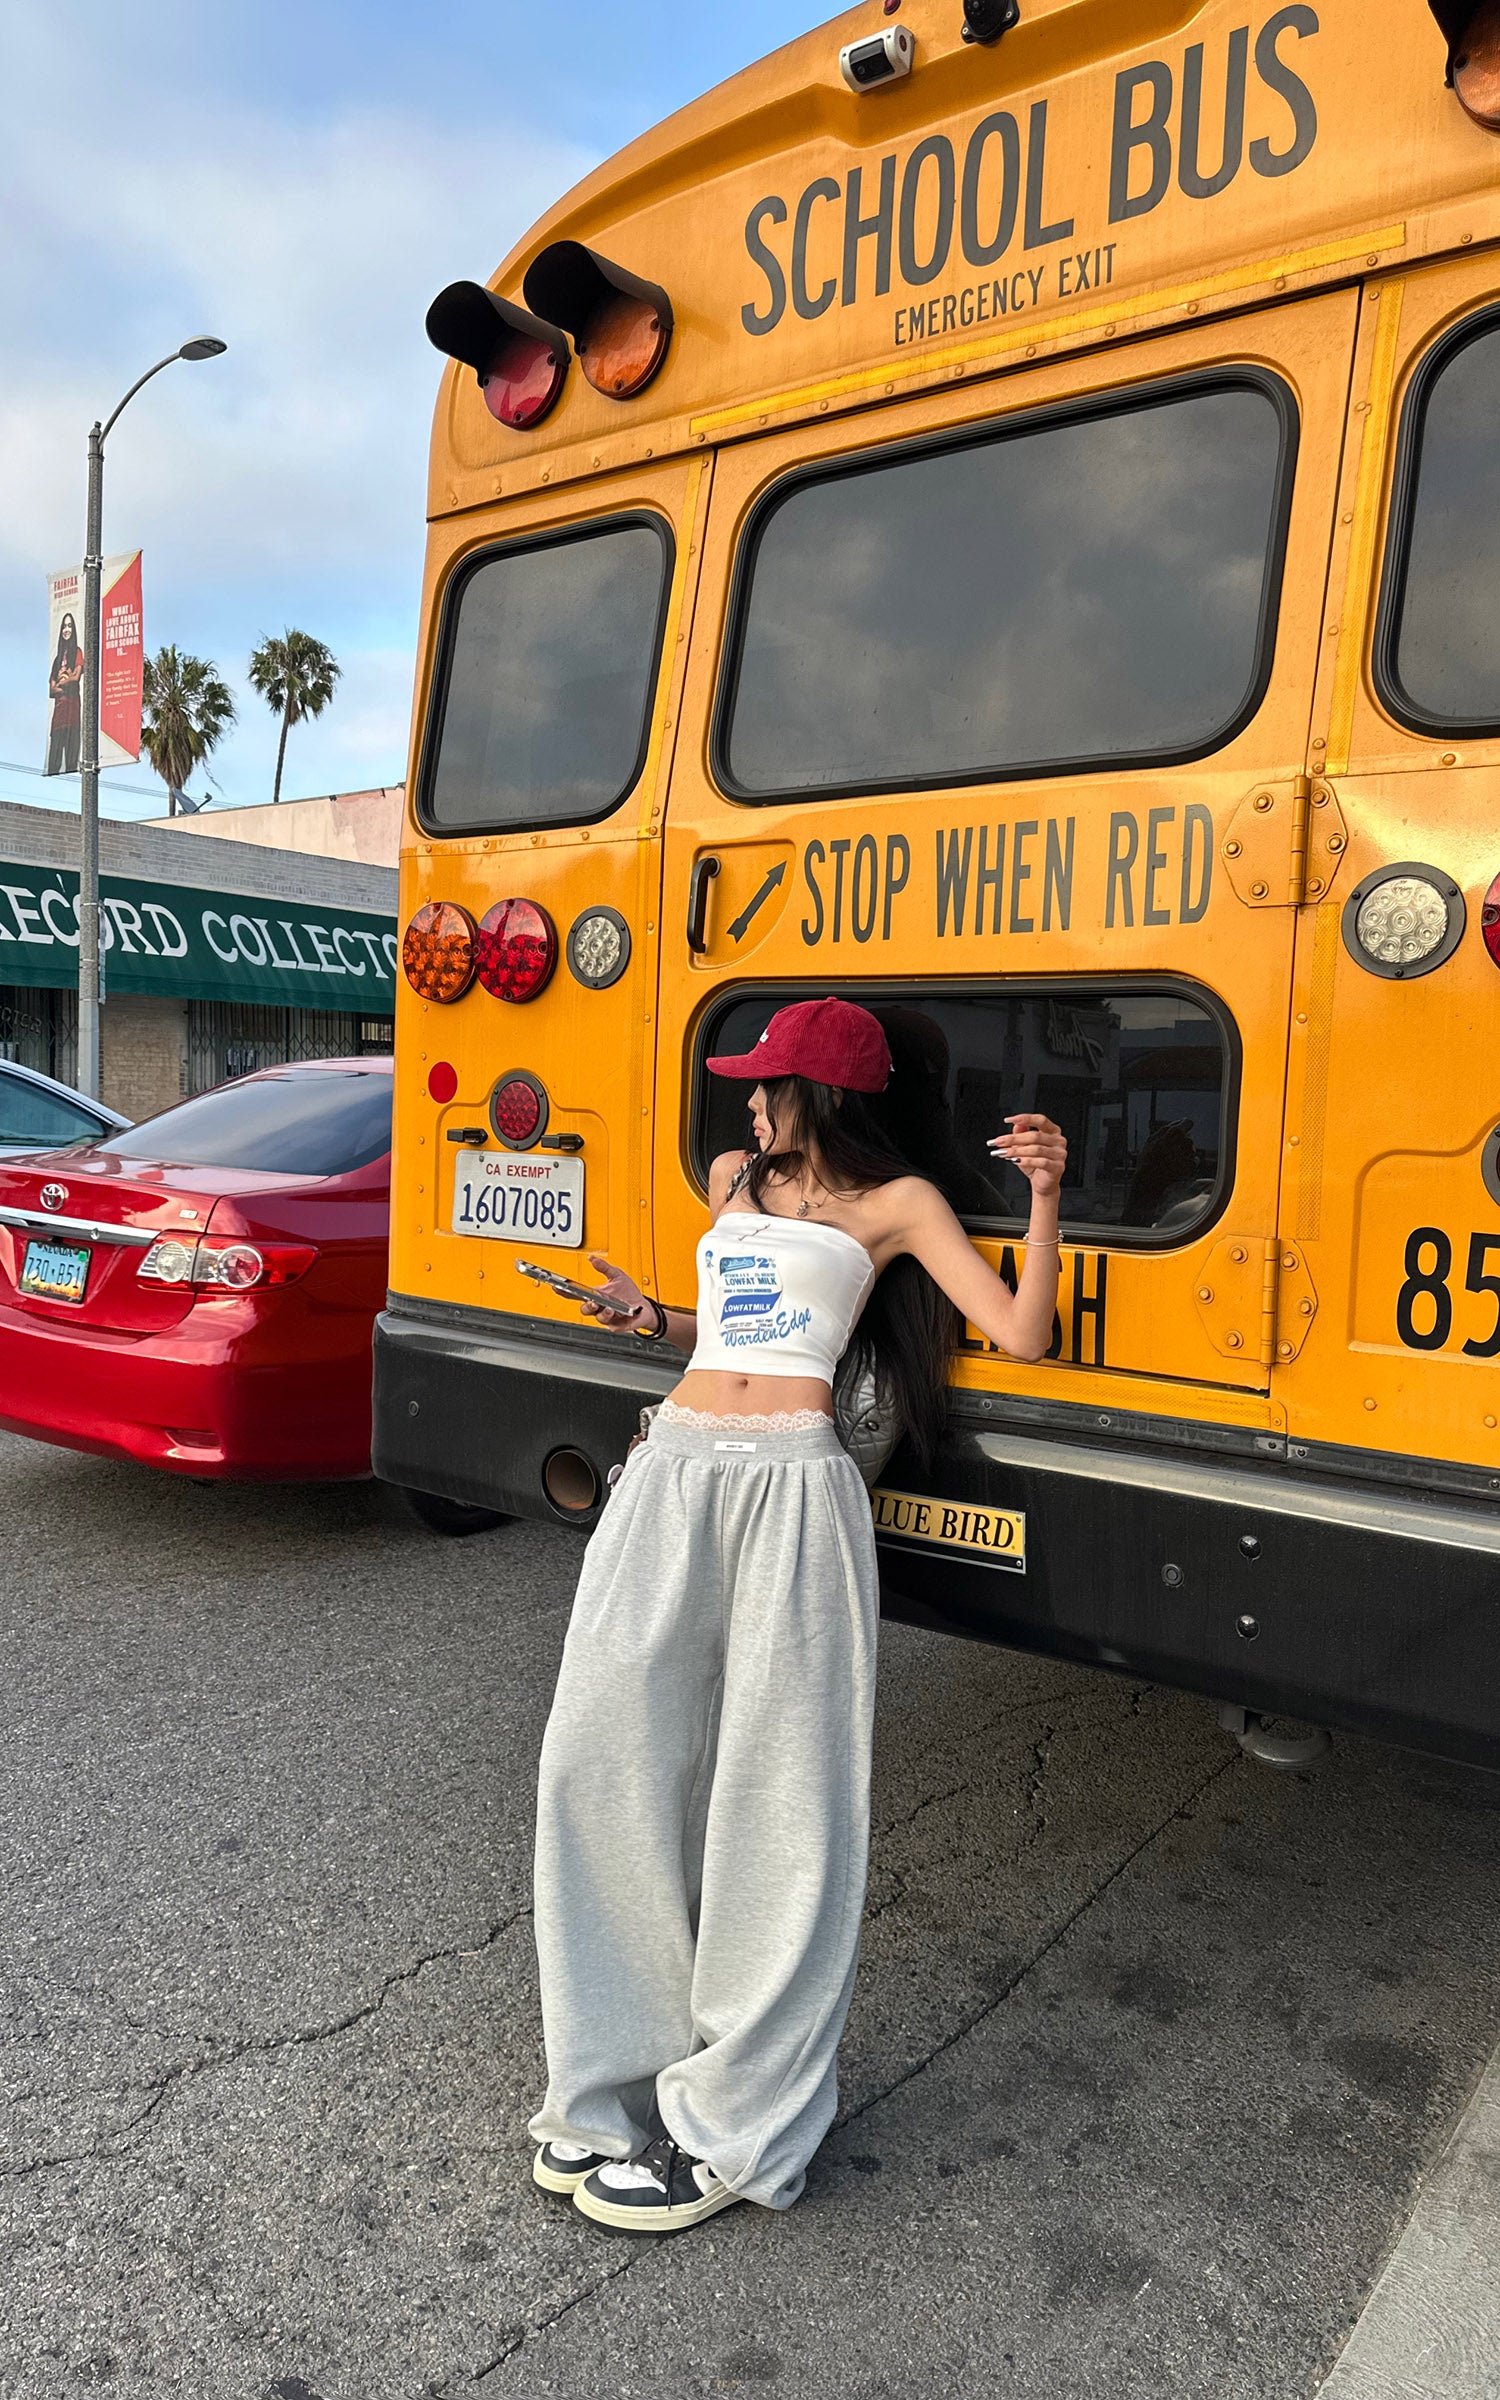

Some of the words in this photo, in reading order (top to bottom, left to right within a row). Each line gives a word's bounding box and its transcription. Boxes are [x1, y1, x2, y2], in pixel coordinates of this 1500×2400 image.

[741, 99, 1074, 336] SCHOOL
[1108, 4, 1319, 225] BUS
[894, 264, 1043, 345] EMERGENCY
[1058, 243, 1117, 298] EXIT
[54, 575, 78, 591] FAIRFAX
[106, 616, 119, 628] LOVE
[120, 612, 140, 625] ABOUT
[112, 604, 129, 617] WHAT
[106, 622, 140, 641] FAIRFAX
[119, 635, 140, 647] SCHOOL
[801, 833, 910, 946] STOP
[936, 816, 1075, 937] WHEN
[1105, 803, 1213, 928] RED
[0, 884, 188, 958] ECORD
[486, 1163, 501, 1176] CA
[507, 1164, 552, 1179] EXEMPT
[460, 1183, 572, 1233] 1607085
[725, 1277, 755, 1286] LOWFAT
[757, 1277, 778, 1285] MILK
[868, 1494, 932, 1535] LUE
[939, 1507, 1015, 1549] BIRD
